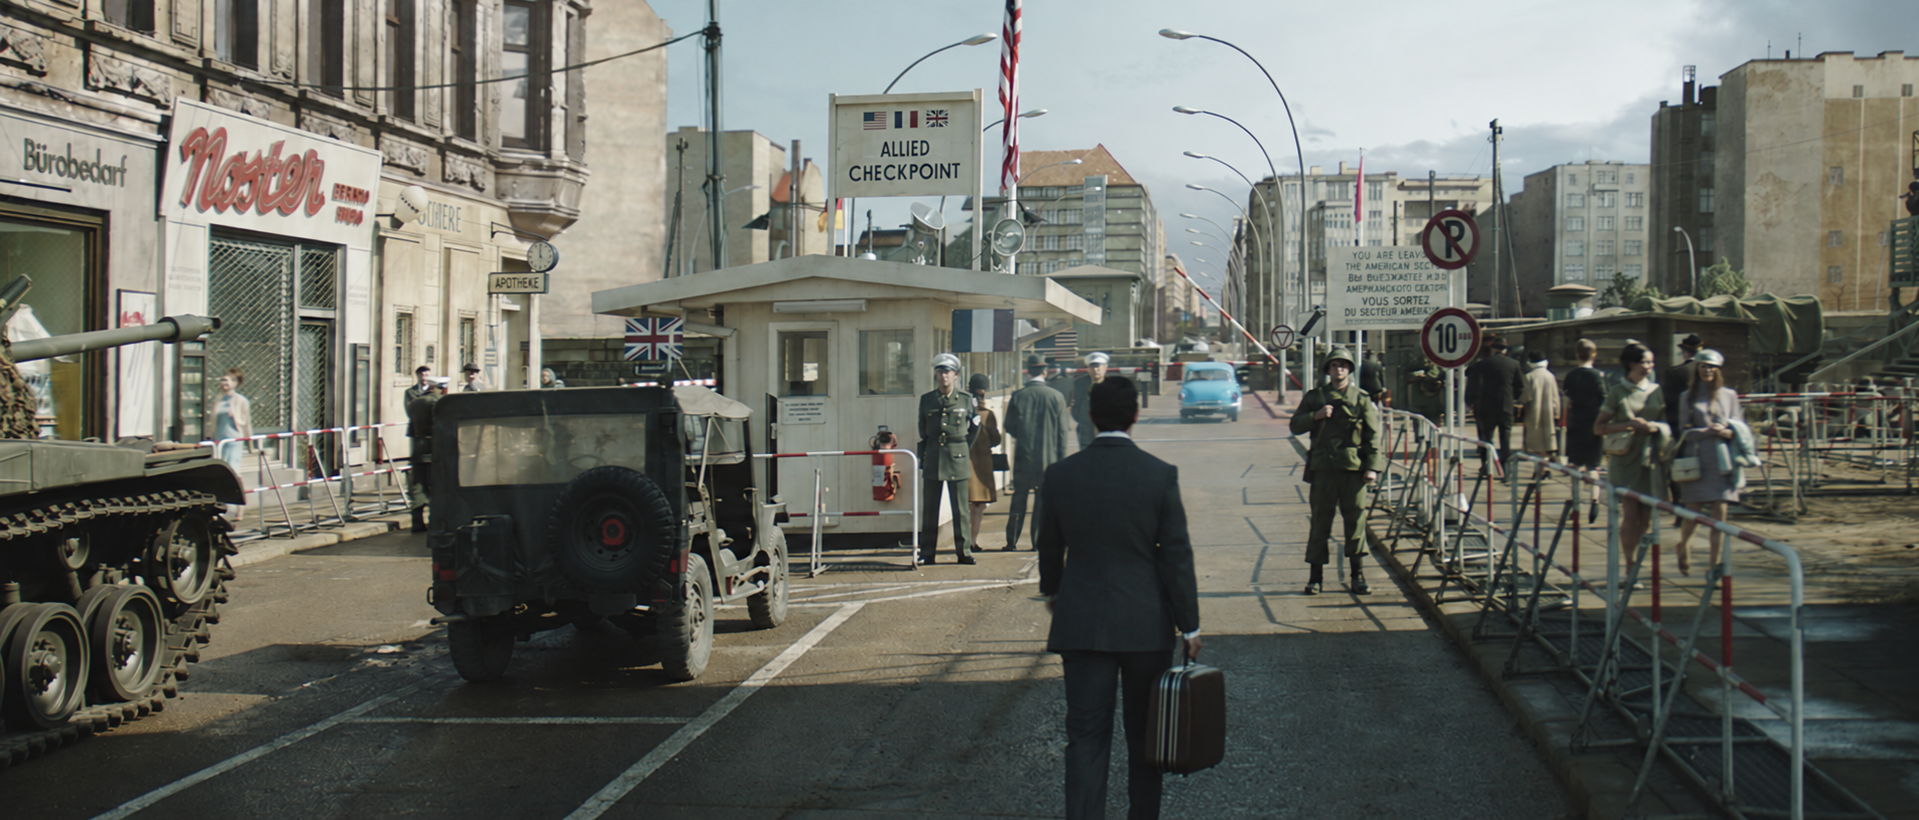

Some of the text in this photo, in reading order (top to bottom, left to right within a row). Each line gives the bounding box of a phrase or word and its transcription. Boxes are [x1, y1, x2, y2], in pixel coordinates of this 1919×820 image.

[880, 140, 930, 158] ALLIED
[24, 138, 127, 188] Bürobedarf
[849, 163, 961, 182] CHECKPOINT
[1445, 220, 1466, 259] P
[1352, 251, 1371, 260] YOU
[1376, 251, 1394, 260] ARE
[1346, 262, 1362, 271] THE
[1365, 262, 1410, 271] AMERICAN
[495, 277, 539, 289] APOTHEKE
[1361, 295, 1431, 306] VOUS SORTEZ
[1344, 308, 1357, 317] DU
[1360, 307, 1397, 317] SECTEUR
[1435, 323, 1458, 354] 10
